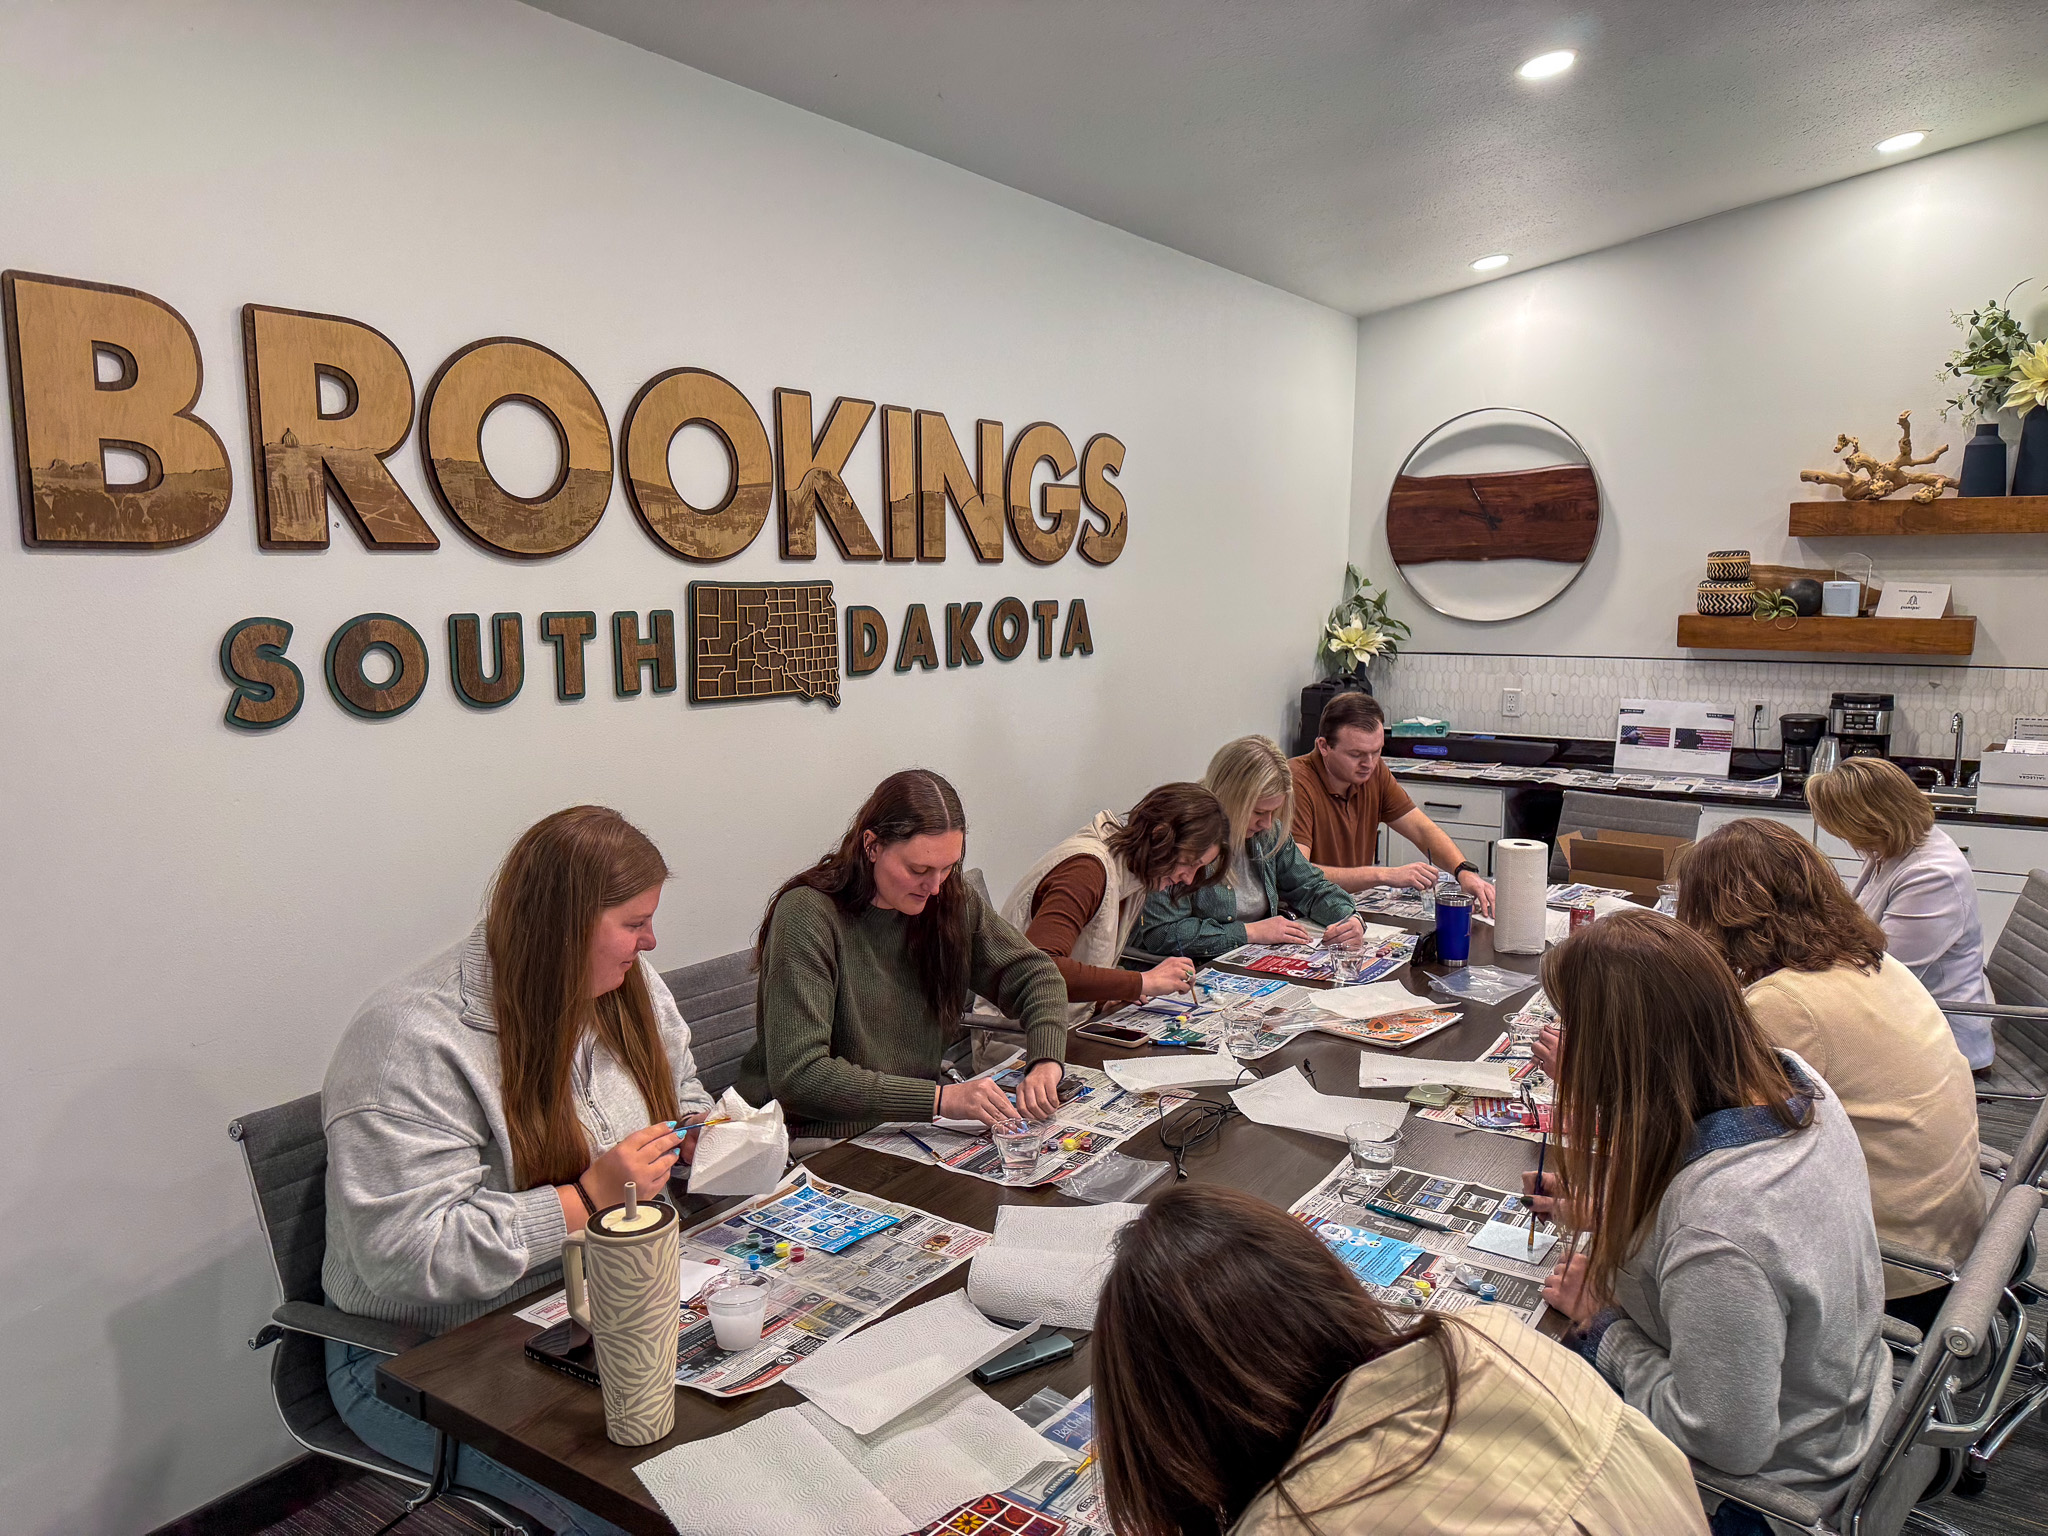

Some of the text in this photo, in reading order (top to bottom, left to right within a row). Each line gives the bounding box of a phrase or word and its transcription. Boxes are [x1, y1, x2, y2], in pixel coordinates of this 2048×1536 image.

[2, 269, 1128, 567] BROOKINGS
[219, 596, 1094, 730] SOUTH DAKOTA
[1052, 1425, 1072, 1439] Best
